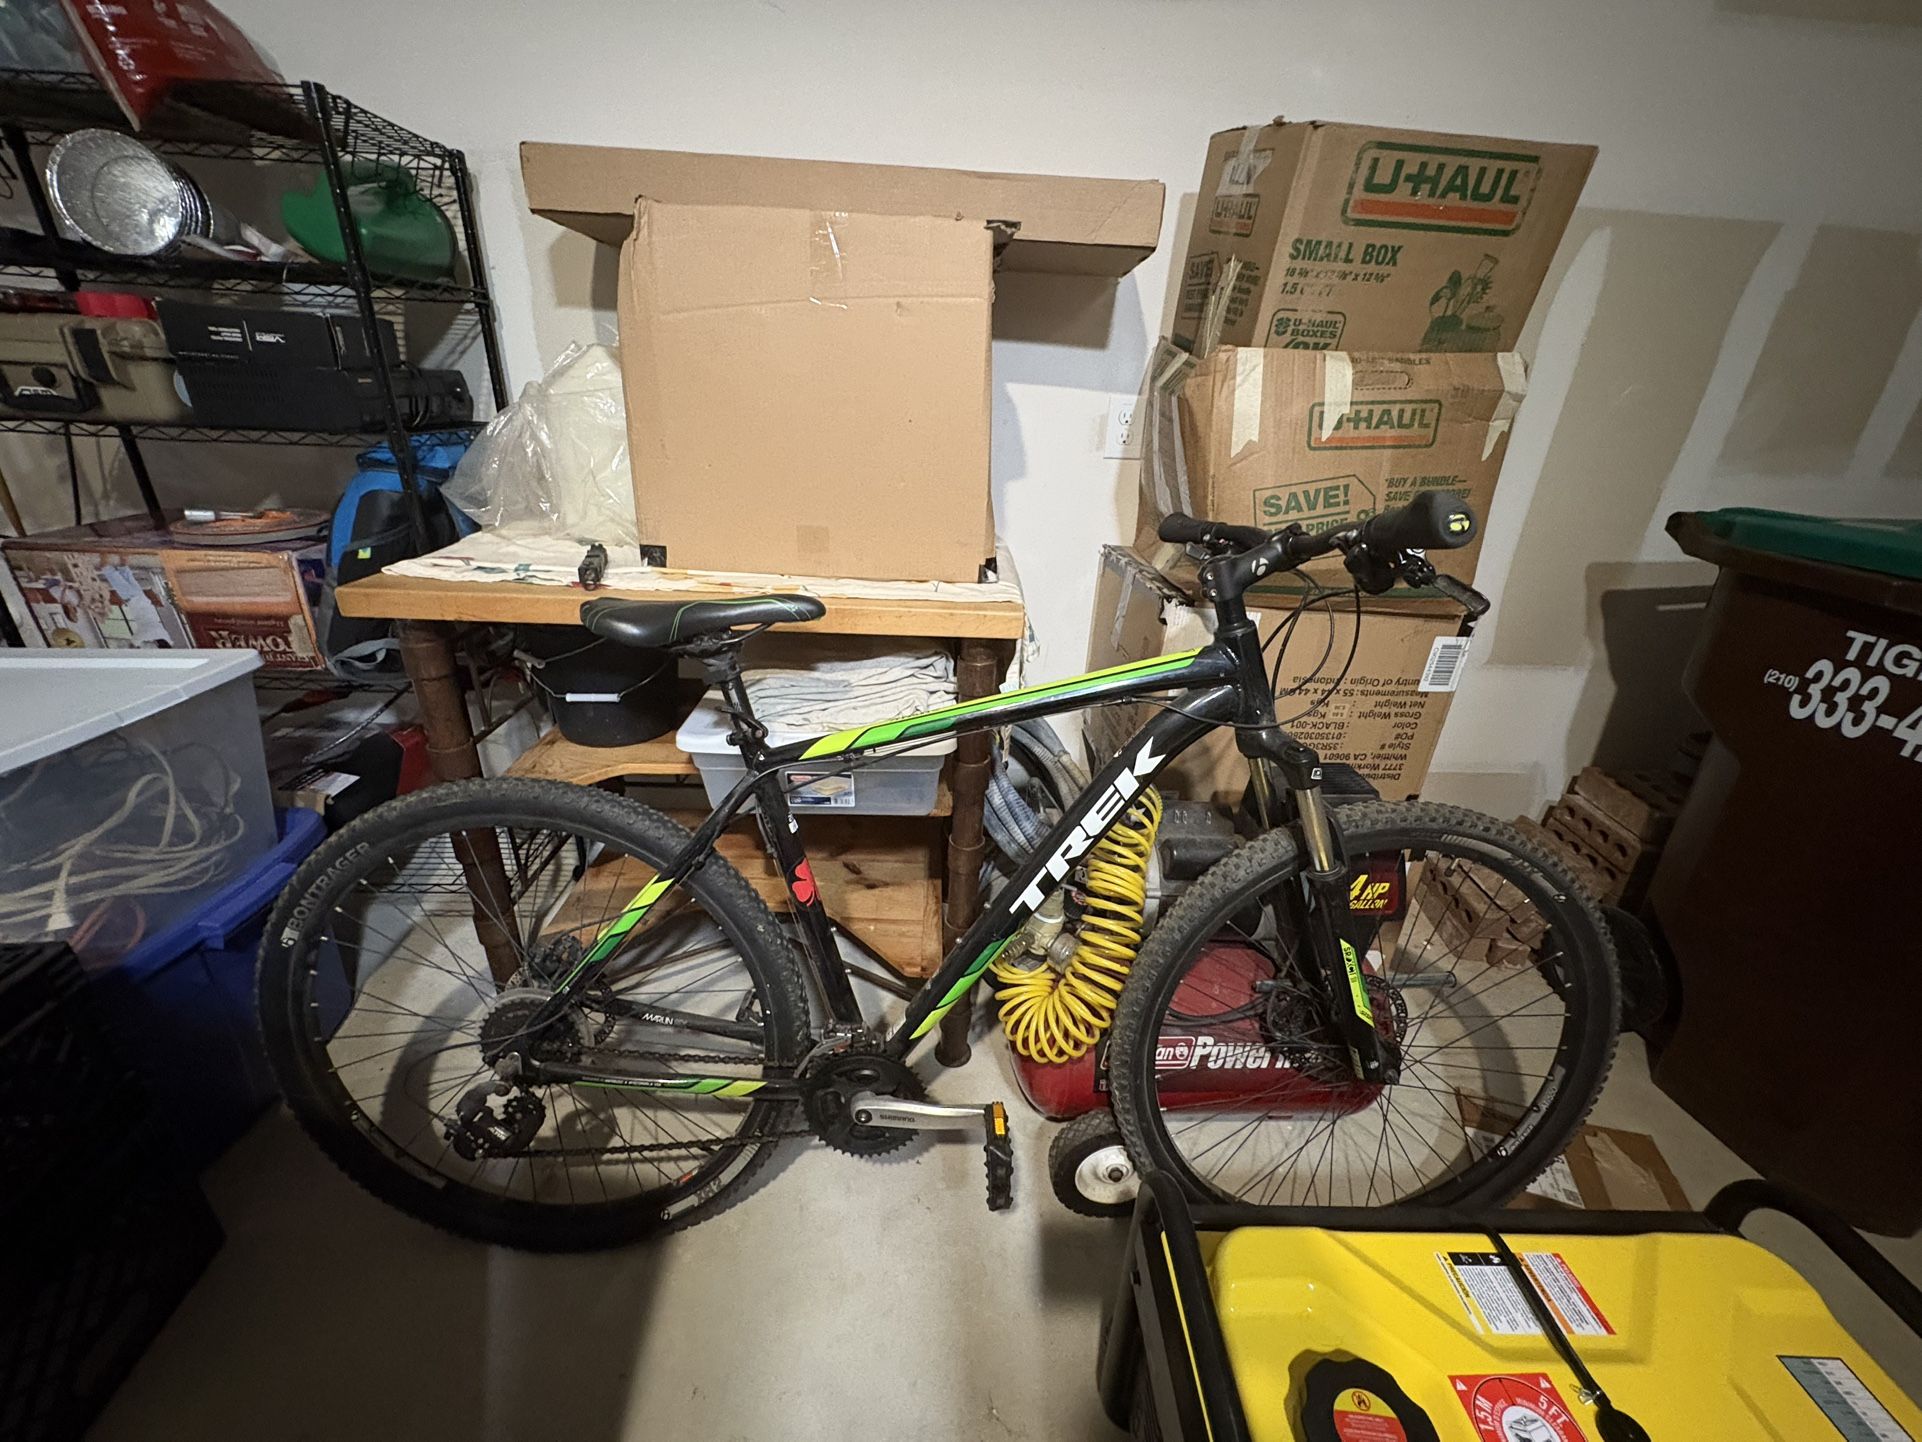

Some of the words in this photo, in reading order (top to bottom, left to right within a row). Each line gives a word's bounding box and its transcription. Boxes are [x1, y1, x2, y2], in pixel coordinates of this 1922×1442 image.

[1364, 157, 1522, 205] U-HAUL
[1289, 238, 1354, 264] SMALL
[1360, 243, 1403, 267] BOX
[1290, 329, 1337, 339] BOXES
[1410, 477, 1418, 488] A
[1262, 483, 1350, 517] SAVE!
[1385, 490, 1413, 502] SAVE
[1845, 629, 1922, 683] TIG
[1350, 677, 1380, 689] Origin
[1373, 699, 1408, 709] Weight
[1408, 700, 1427, 709] Net
[1306, 710, 1328, 720] Kgs
[1357, 710, 1391, 720] Weight
[1393, 711, 1423, 720] Gross
[1764, 668, 1799, 692] (210)
[1789, 658, 1922, 764] 333-4
[1392, 721, 1419, 731] Color
[1394, 732, 1415, 741] PO#
[1379, 743, 1389, 751] #
[1389, 742, 1412, 752] Style
[1323, 752, 1352, 761] 90601
[1353, 752, 1368, 761] CA
[1369, 751, 1408, 761] Whittier,
[1382, 762, 1405, 772] 3777
[1008, 736, 1167, 915] TREK
[286, 841, 370, 933] BONTRAGER
[641, 1012, 674, 1026] MARLIN
